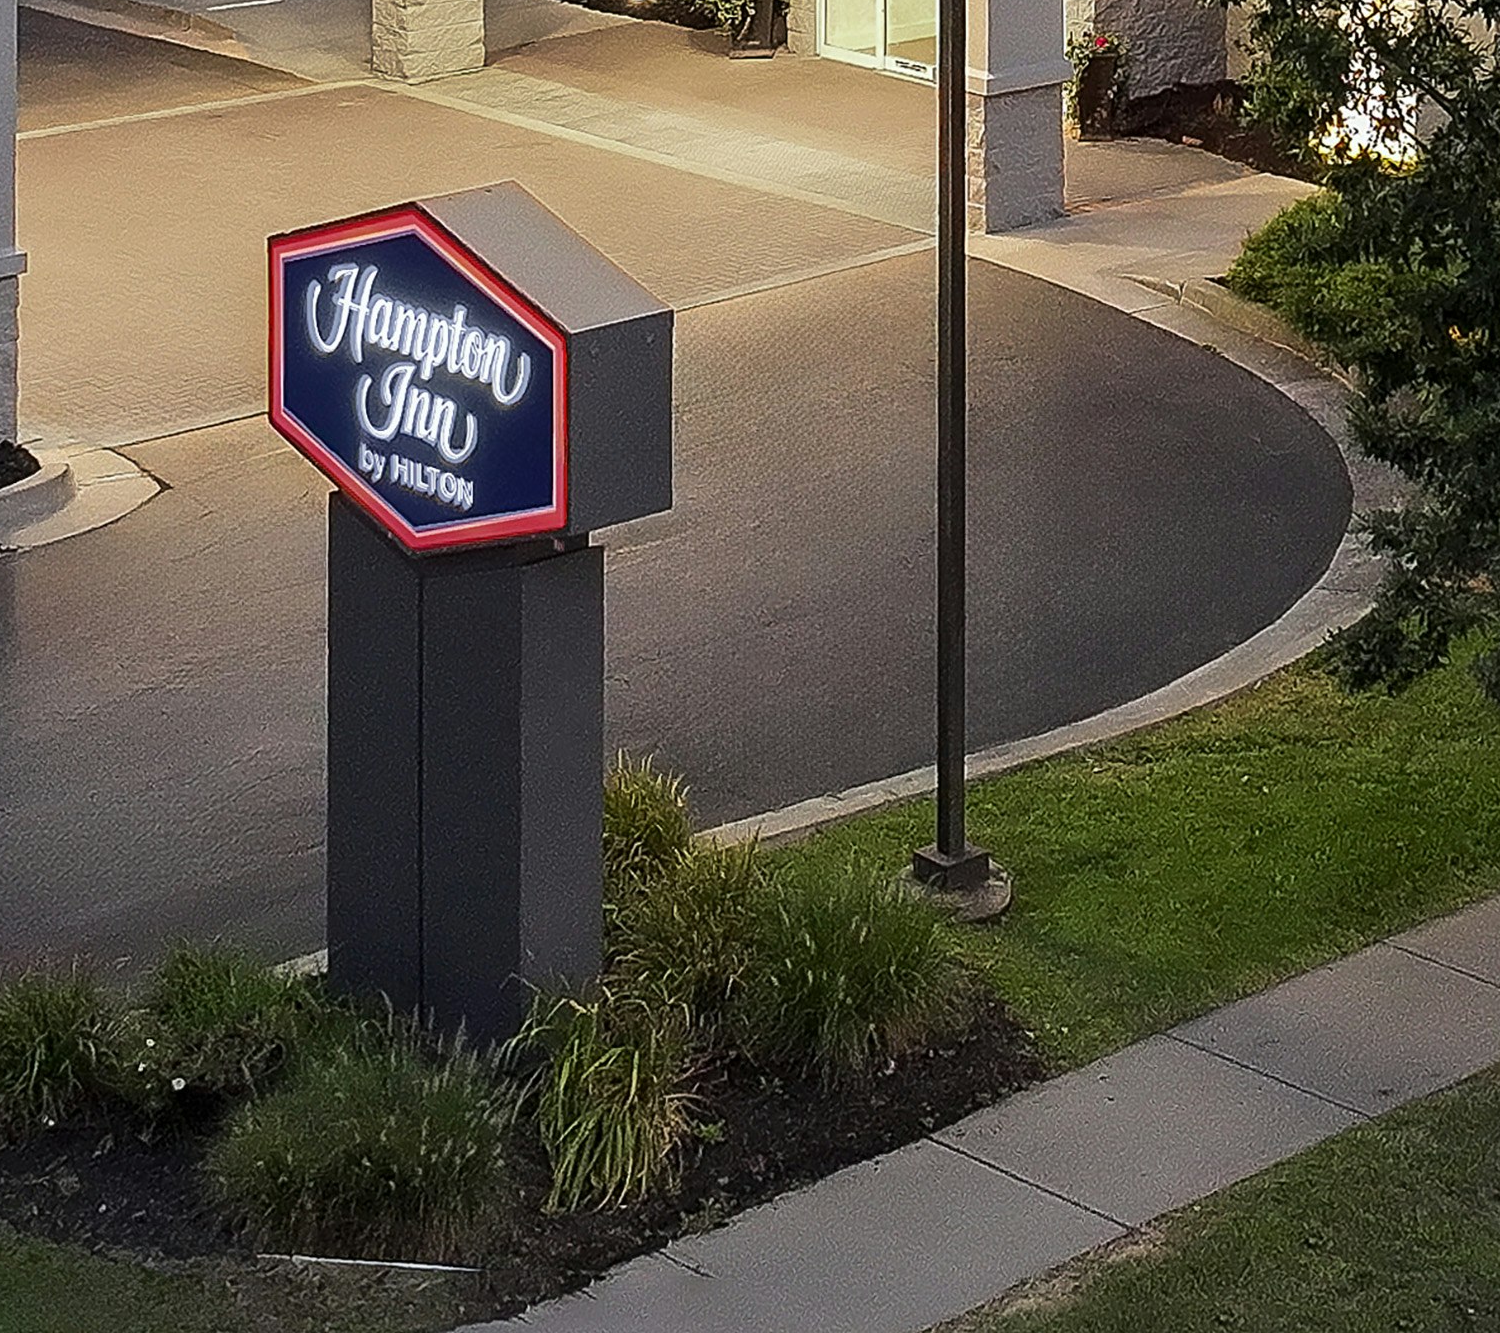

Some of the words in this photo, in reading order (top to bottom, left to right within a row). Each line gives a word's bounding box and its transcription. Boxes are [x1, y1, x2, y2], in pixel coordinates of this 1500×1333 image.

[306, 262, 532, 406] Hampton
[356, 362, 478, 463] Inn
[358, 441, 386, 484] by
[389, 453, 474, 511] HILTON
